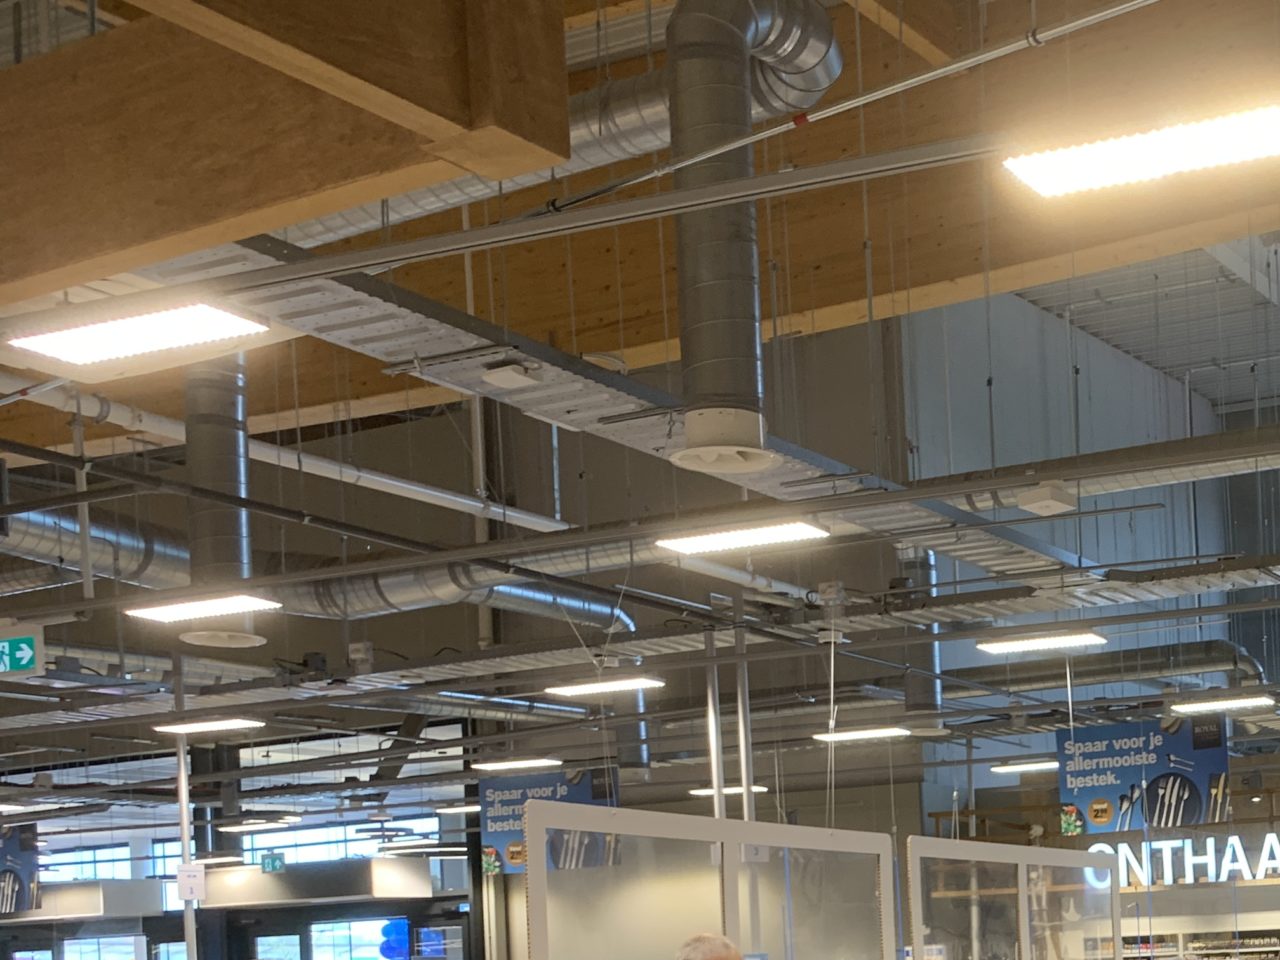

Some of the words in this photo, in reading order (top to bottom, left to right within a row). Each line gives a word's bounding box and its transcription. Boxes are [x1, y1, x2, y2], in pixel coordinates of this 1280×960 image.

[1064, 739, 1108, 756] Spaar
[1112, 736, 1146, 750] voor
[1148, 732, 1163, 750] je
[1066, 752, 1157, 772] allermooiste
[1066, 771, 1120, 789] bestek.
[485, 789, 523, 804] Spaar
[526, 786, 554, 798] voor
[556, 782, 568, 799] je
[486, 803, 524, 817] allerm
